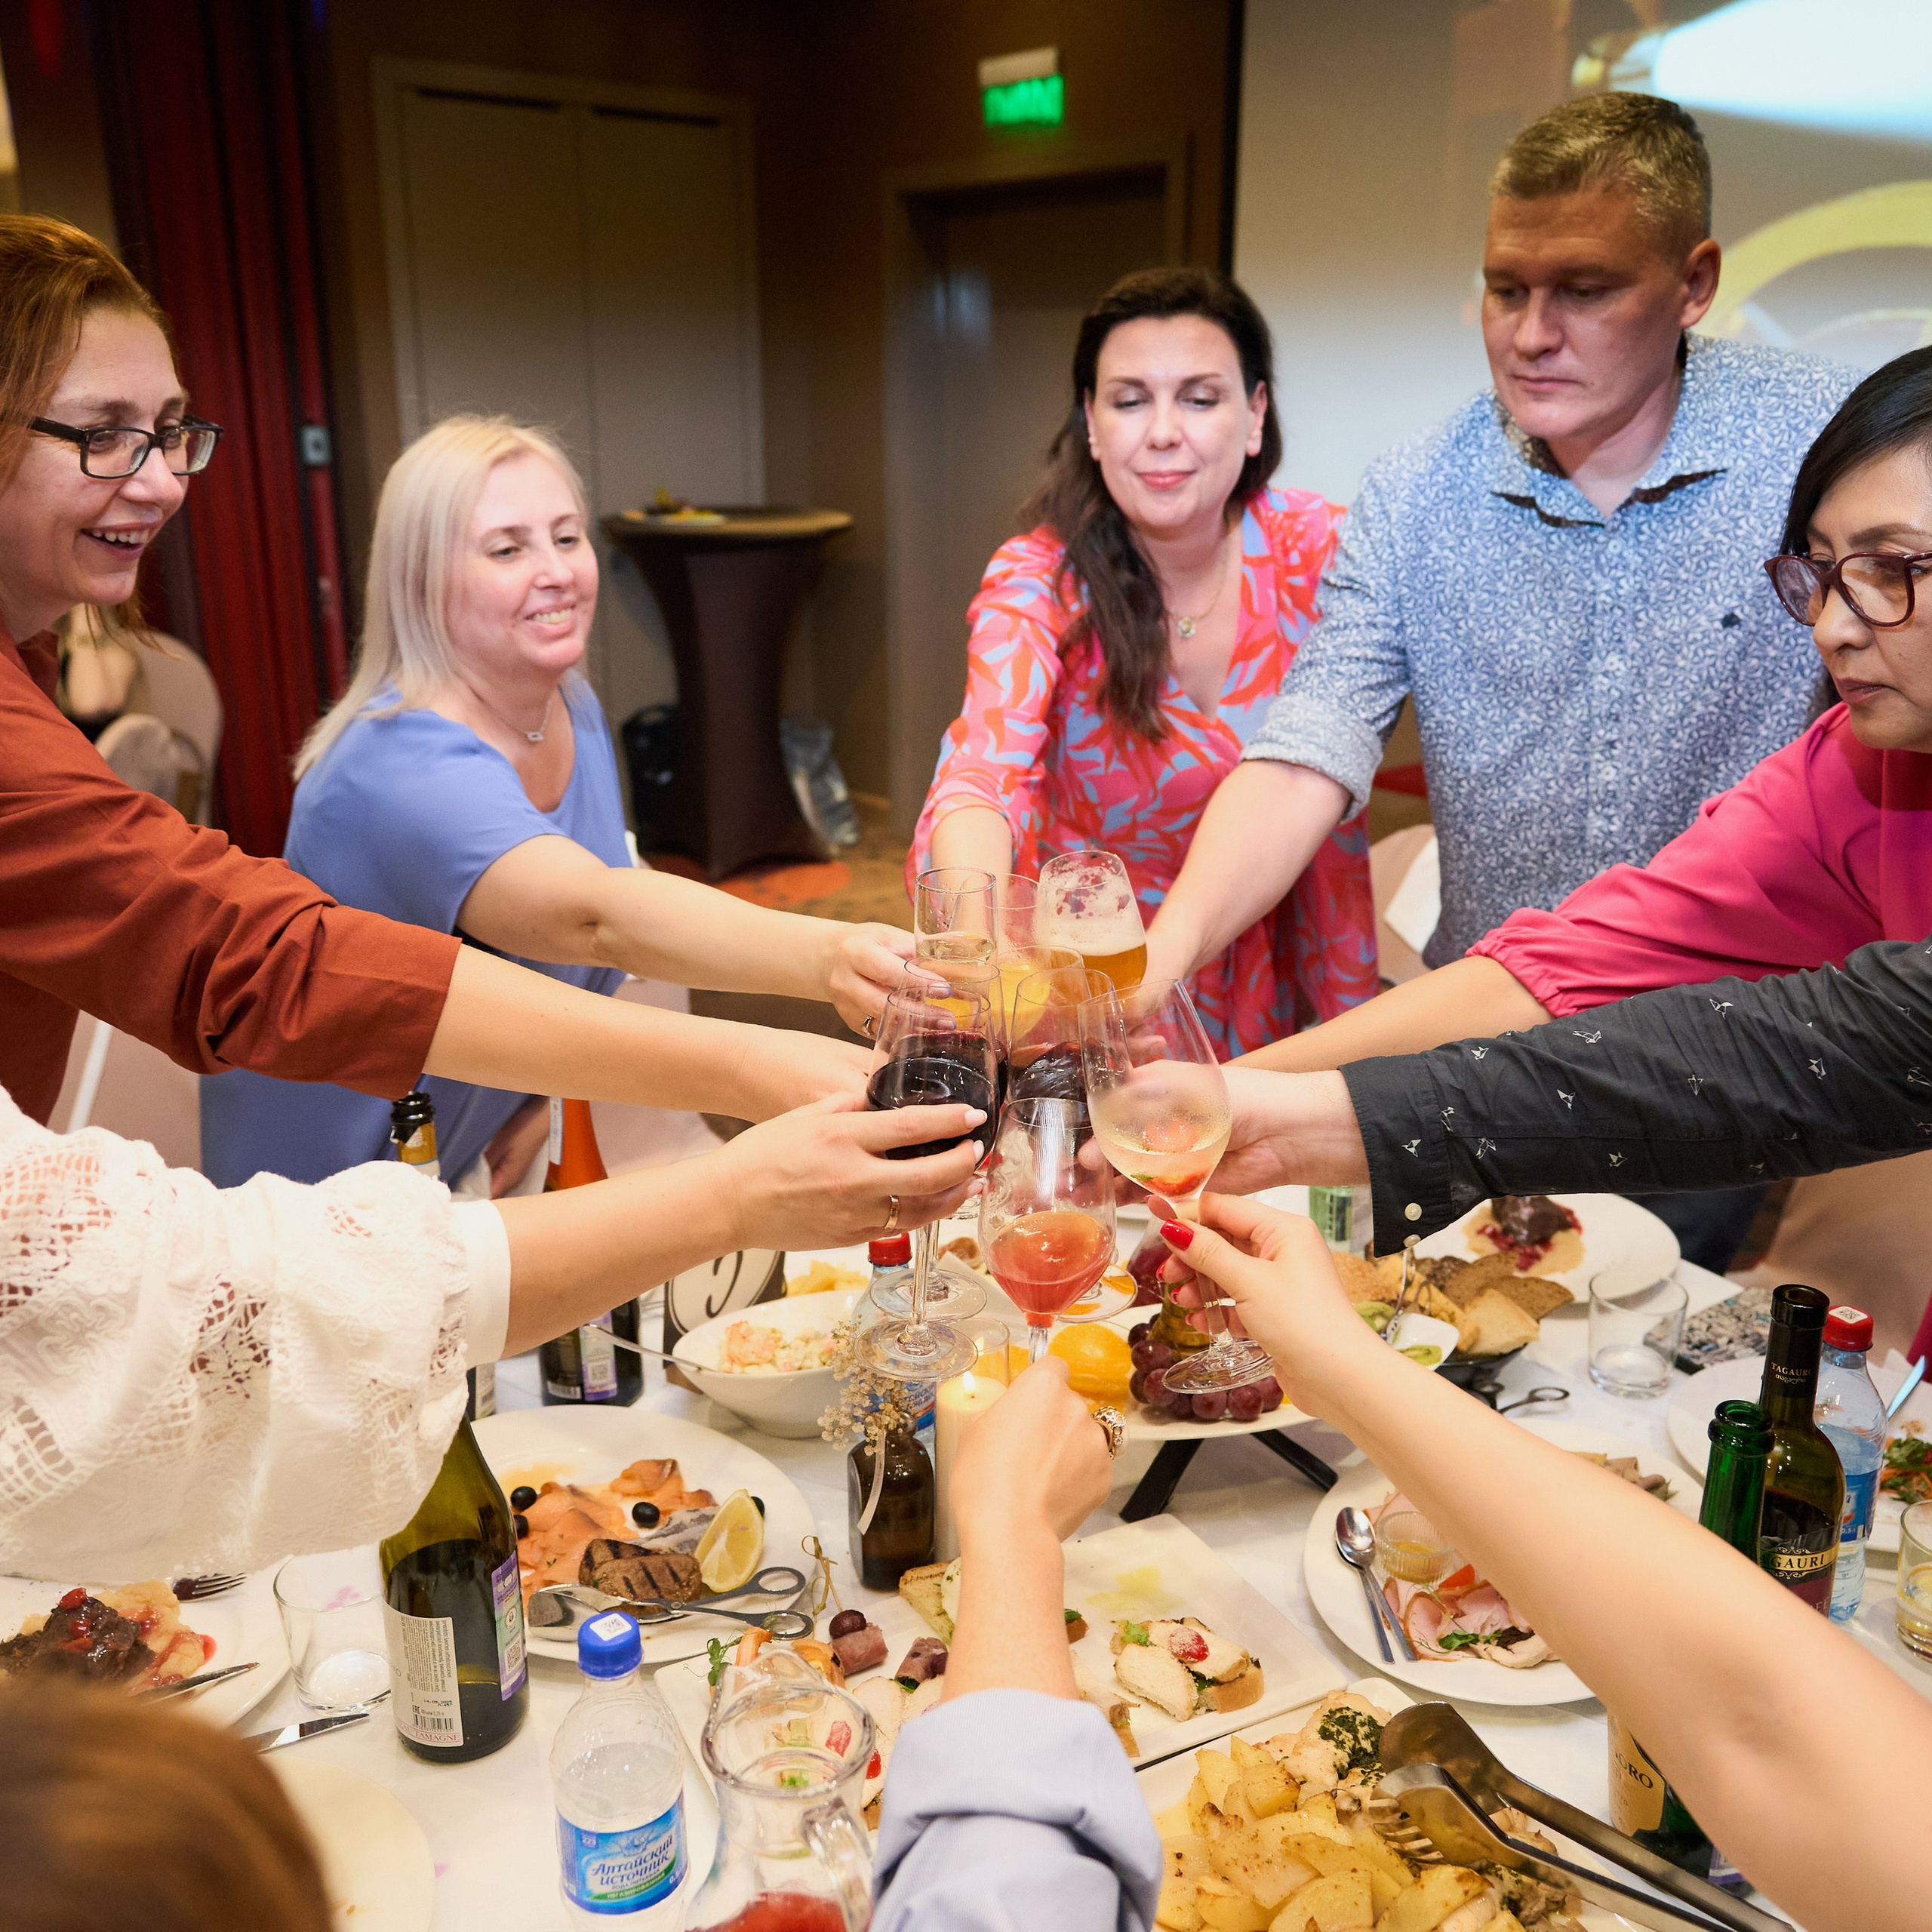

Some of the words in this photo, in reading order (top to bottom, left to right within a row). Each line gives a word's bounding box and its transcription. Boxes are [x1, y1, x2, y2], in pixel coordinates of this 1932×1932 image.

[1771, 1361, 1811, 1376] TAGAURI
[415, 1730, 461, 1741] TAMAGNE
[592, 1835, 672, 1876] Алтайский
[600, 1851, 670, 1886] источник
